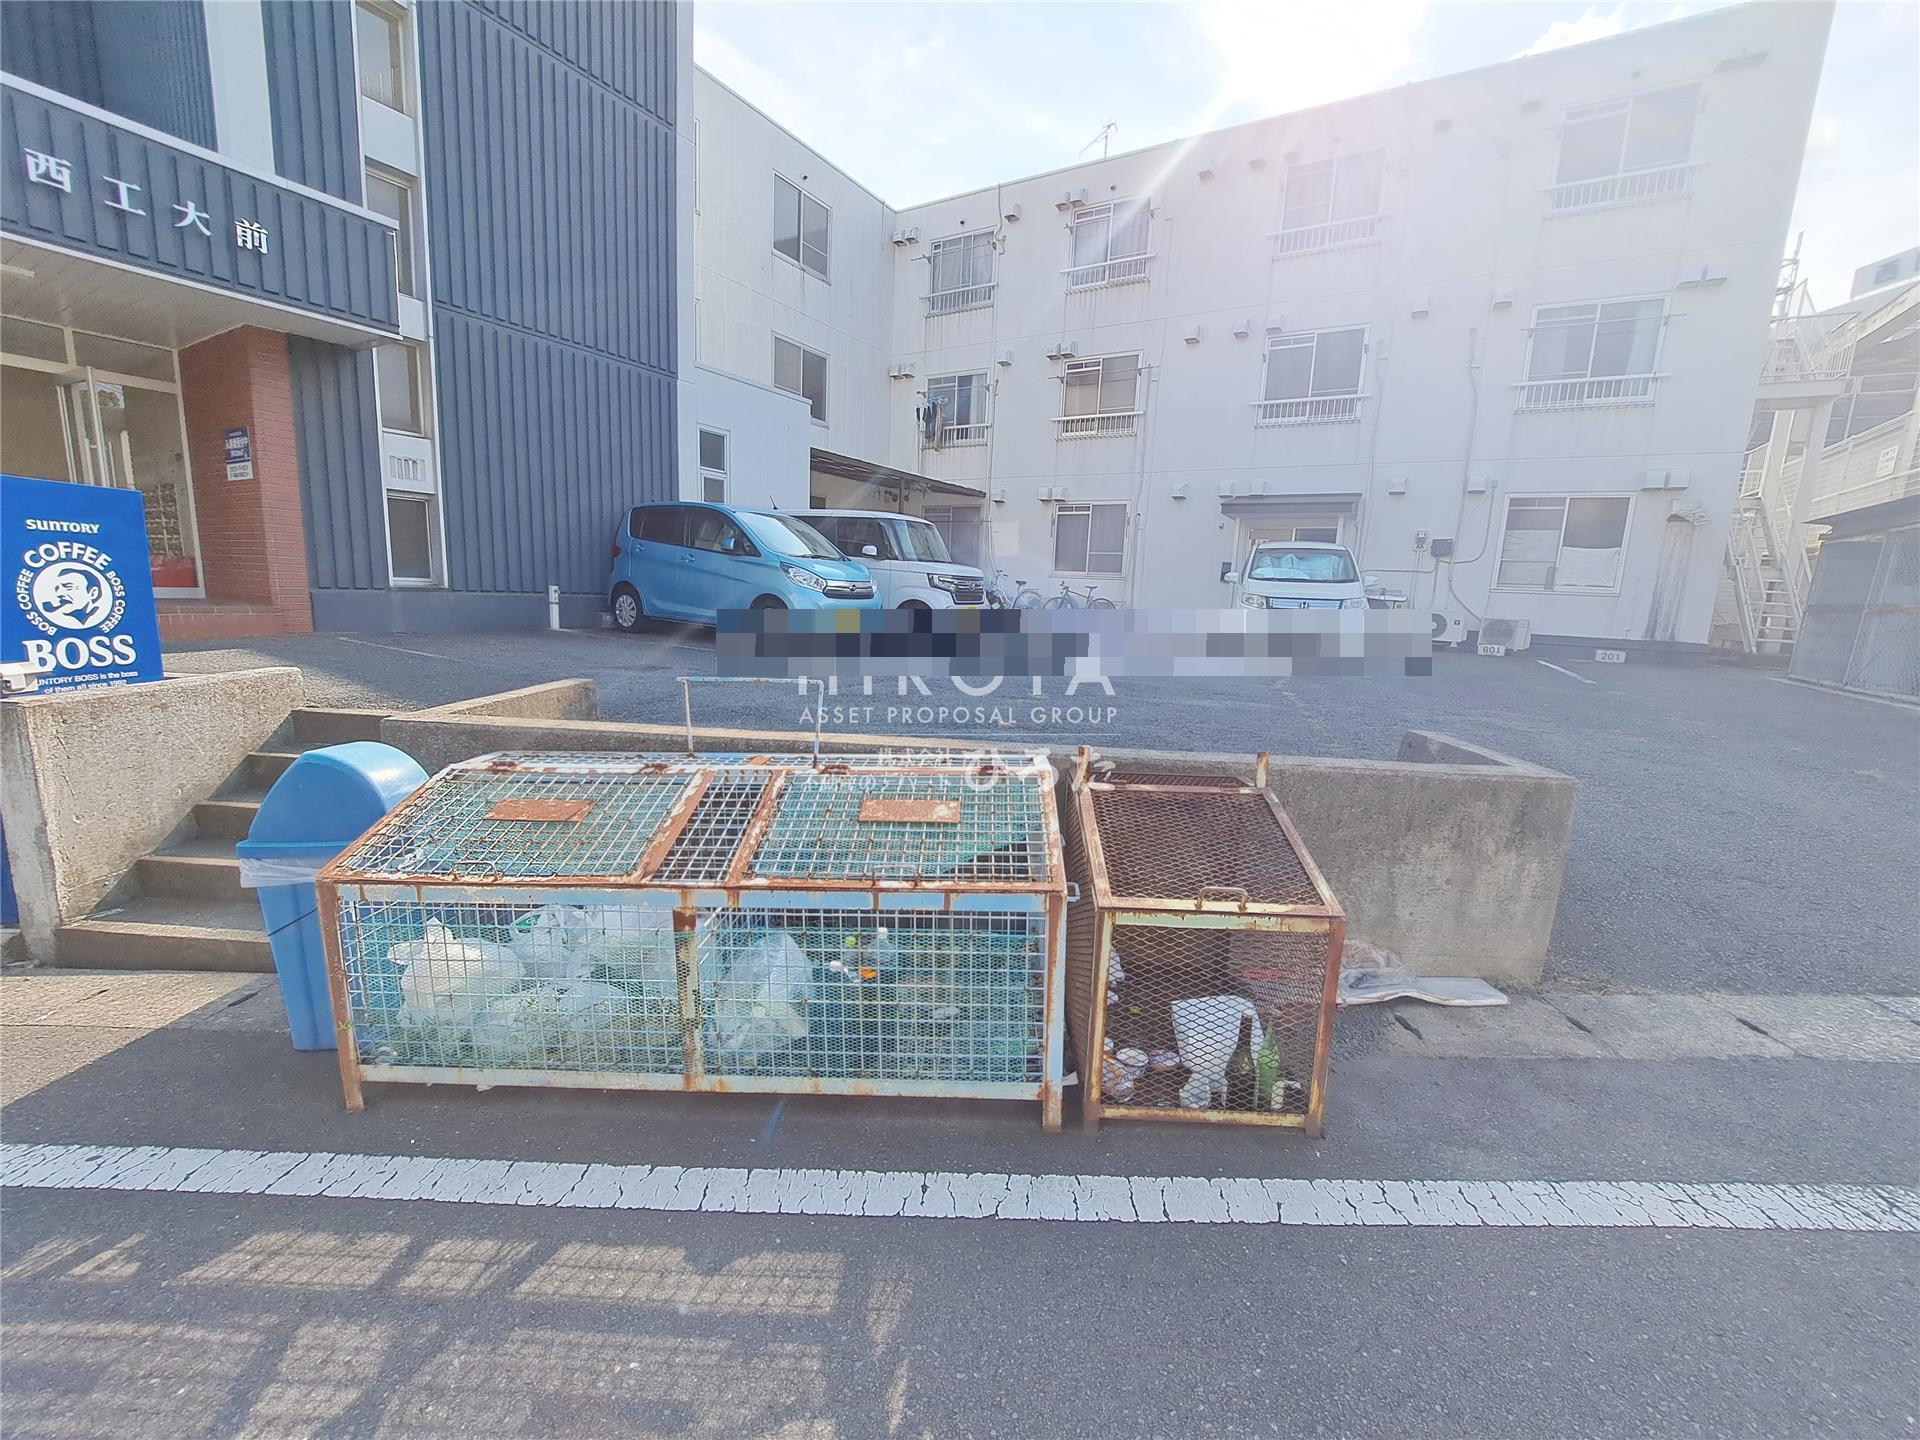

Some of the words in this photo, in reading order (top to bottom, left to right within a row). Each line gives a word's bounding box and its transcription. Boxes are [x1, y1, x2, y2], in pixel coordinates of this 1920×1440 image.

[23, 147, 270, 254] 西工大前
[23, 541, 113, 571] COFFEE
[16, 568, 35, 611] COFFEE
[106, 570, 126, 597] BOSS
[26, 611, 58, 636] BOSS
[99, 599, 126, 634] COFFEE
[22, 634, 137, 670] BOSS
[1600, 652, 1621, 662] 201
[37, 675, 73, 687] UNTORY
[74, 673, 99, 684] BOSS
[121, 671, 138, 679] boss
[55, 685, 76, 693] them
